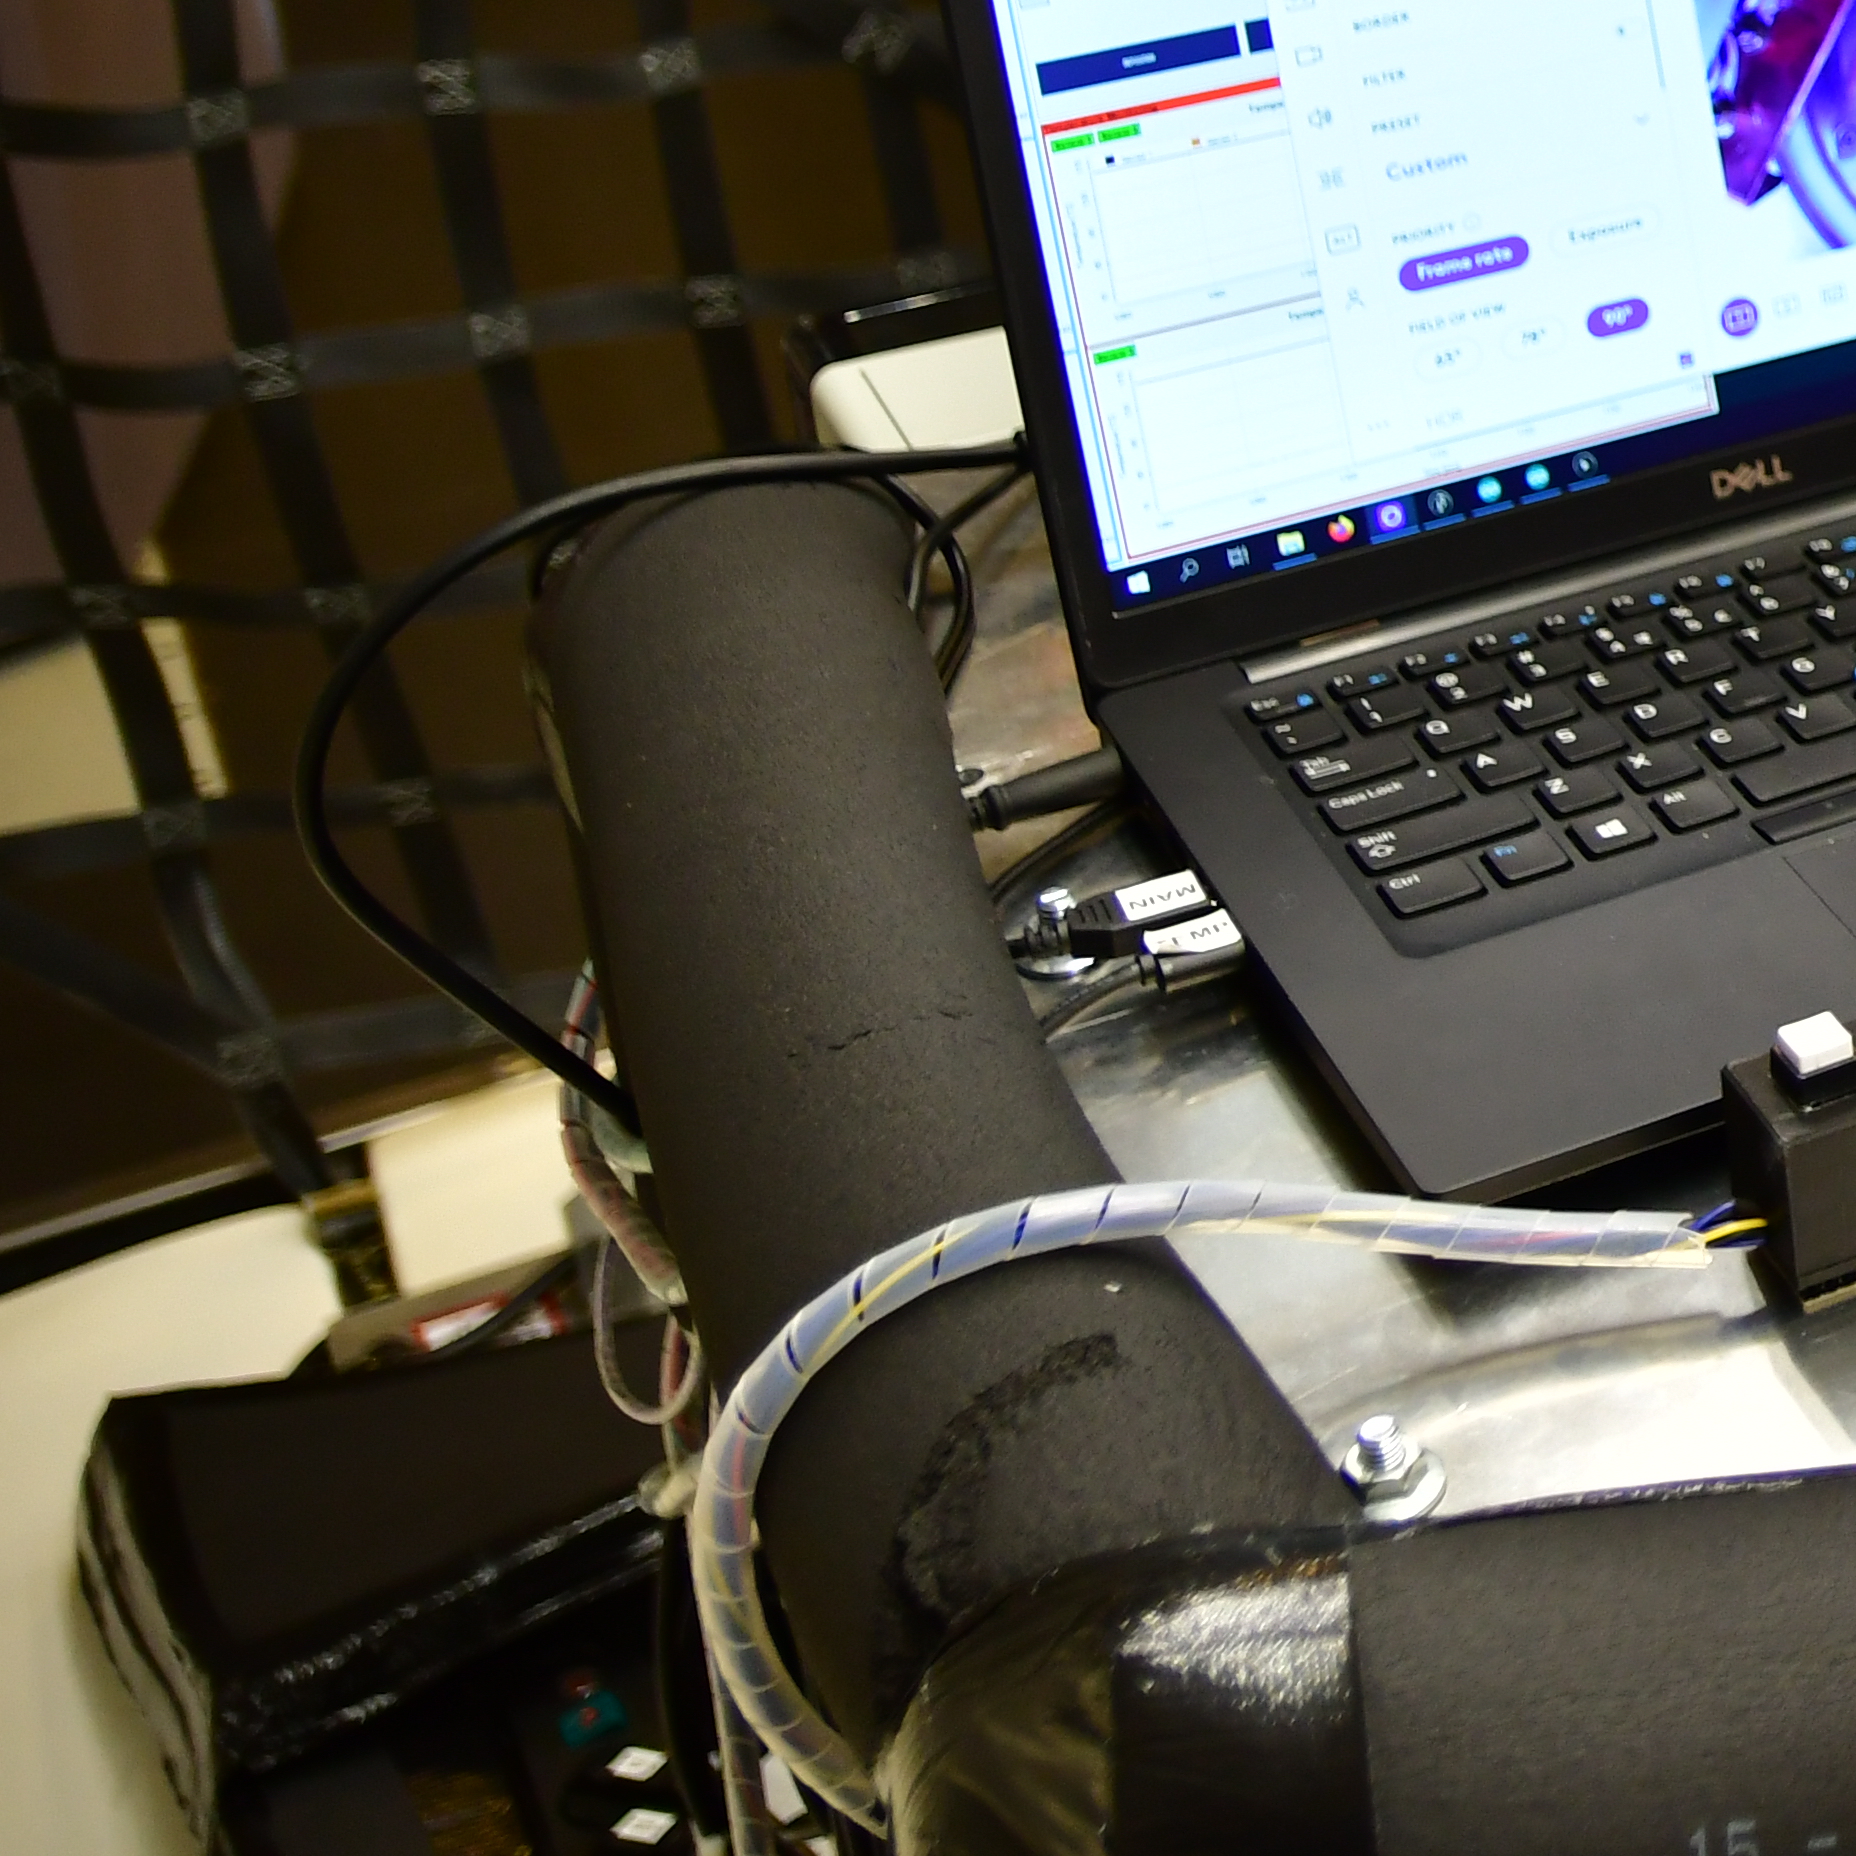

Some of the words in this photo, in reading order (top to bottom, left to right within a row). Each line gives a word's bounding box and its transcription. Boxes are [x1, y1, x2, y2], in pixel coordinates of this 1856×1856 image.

[1385, 151, 1469, 182] Custom
[1416, 254, 1473, 282] Frame
[1473, 244, 1515, 269] rate
[1710, 453, 1794, 501] DELL
[1502, 692, 1533, 712] W
[1785, 703, 1808, 720] V
[1554, 726, 1577, 744] S
[1475, 752, 1498, 770] A
[1626, 752, 1653, 770] X
[1365, 779, 1406, 800] Lock
[1543, 777, 1571, 795] Z
[1662, 790, 1688, 805] Alt
[1357, 829, 1398, 849] Shift
[1387, 872, 1422, 891] Ctrl
[1129, 884, 1196, 910] MAIN
